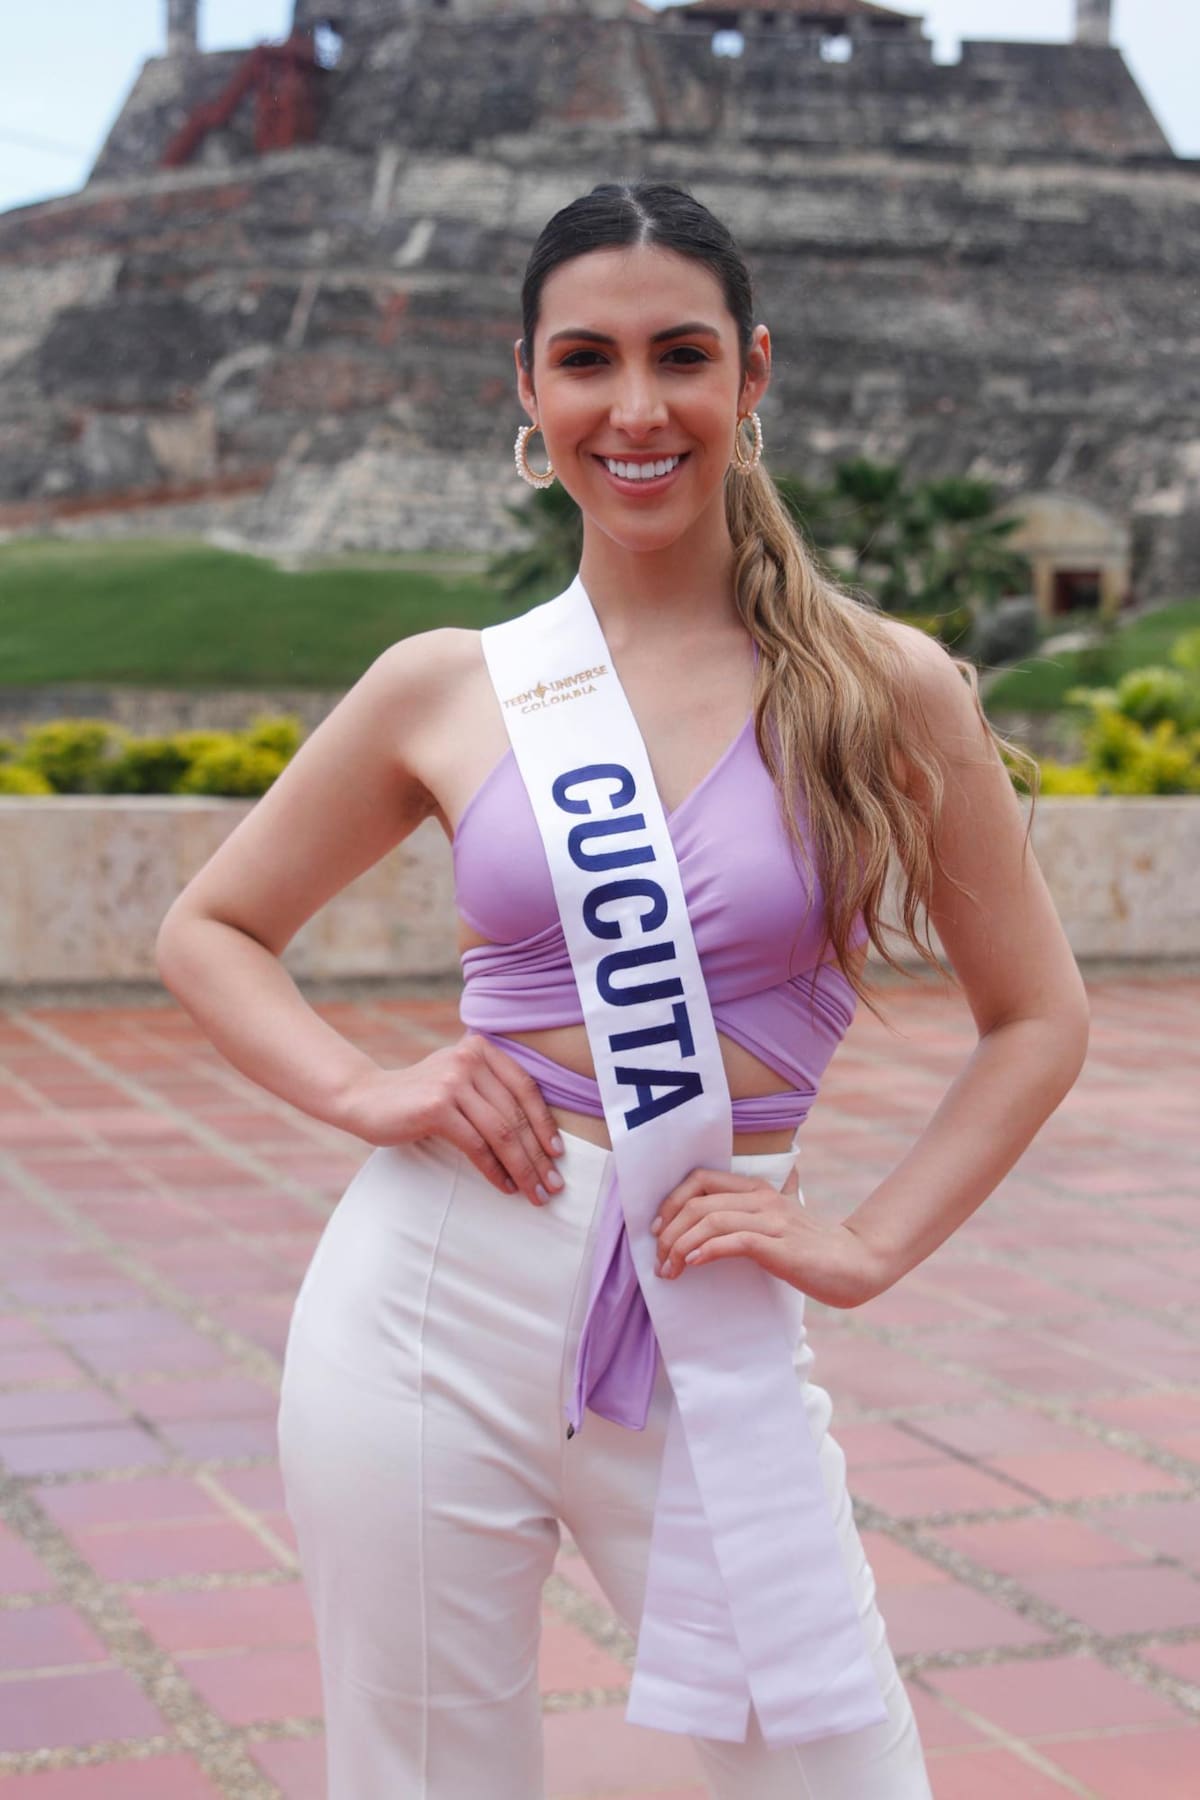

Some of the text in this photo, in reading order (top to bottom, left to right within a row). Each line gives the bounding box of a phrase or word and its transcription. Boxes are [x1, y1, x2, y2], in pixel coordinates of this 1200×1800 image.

[504, 665, 608, 709] TEEN UNIVERSE
[521, 684, 597, 714] COLOMBIA
[552, 763, 704, 1131] CUCUTA
